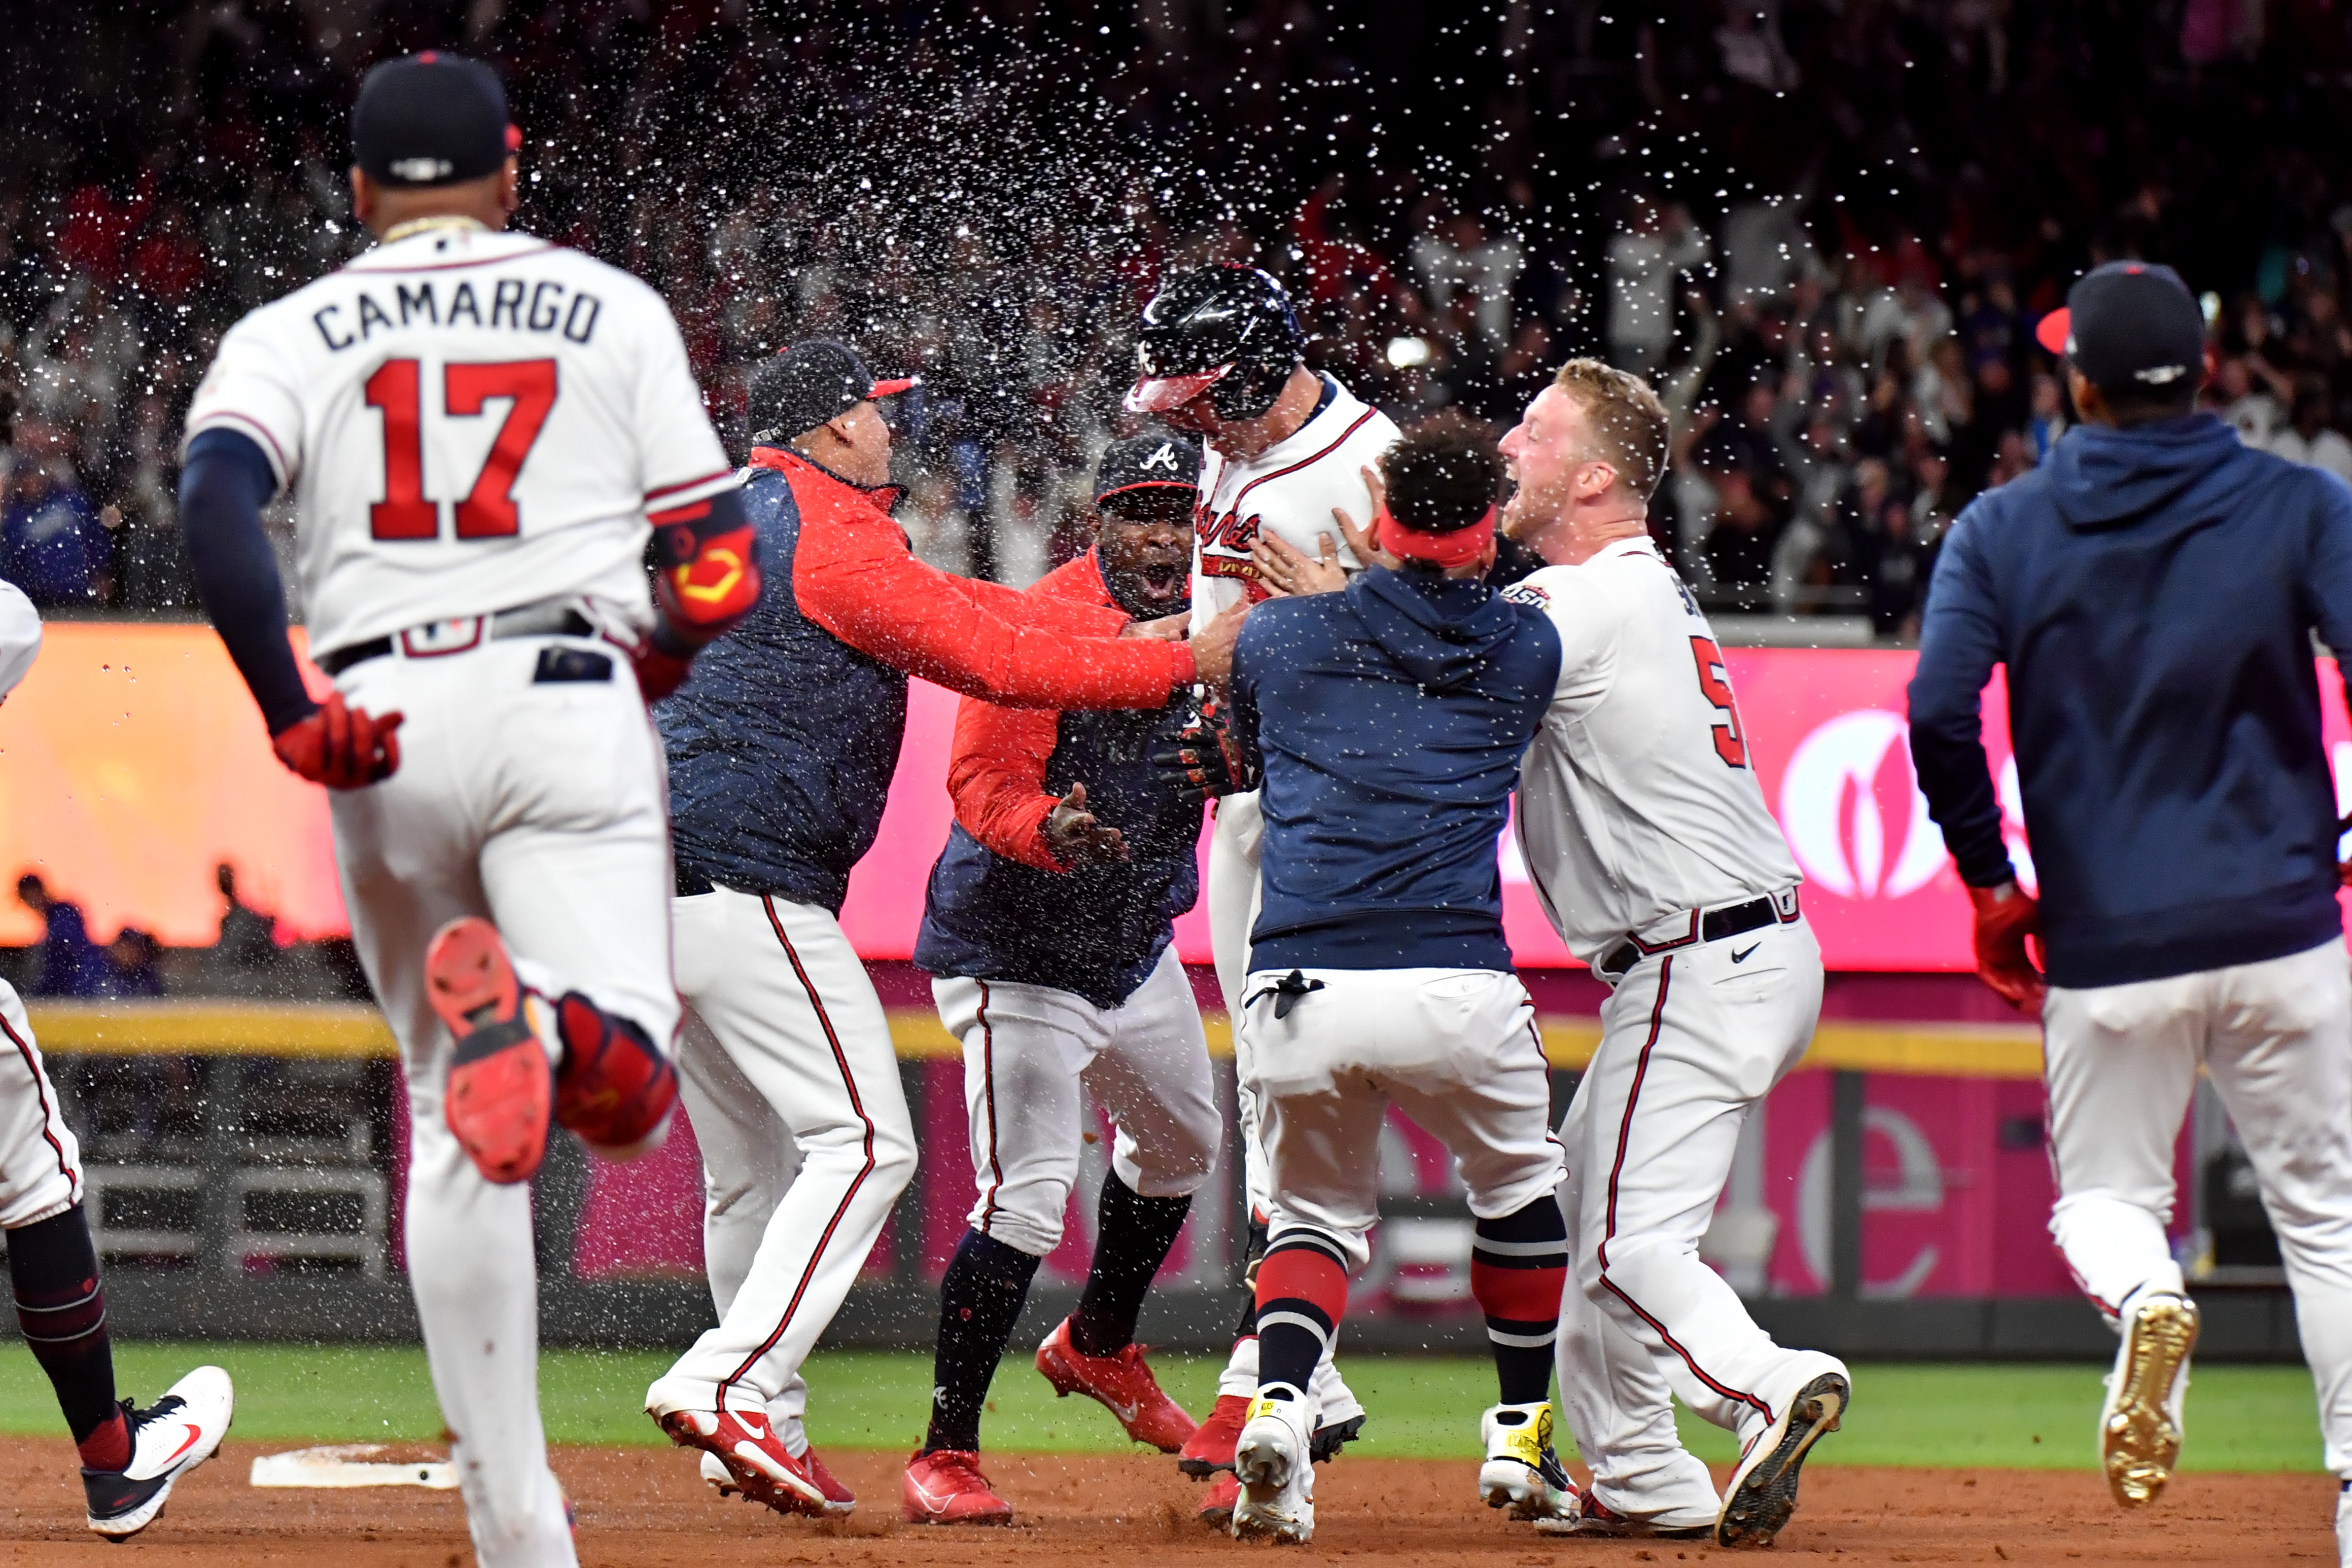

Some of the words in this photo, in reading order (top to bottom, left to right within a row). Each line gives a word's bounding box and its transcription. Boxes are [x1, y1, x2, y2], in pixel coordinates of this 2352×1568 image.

[313, 280, 601, 351] CAMARGO
[364, 358, 558, 542] 17
[1140, 443, 1178, 471] A
[1689, 635, 1754, 770] 5
